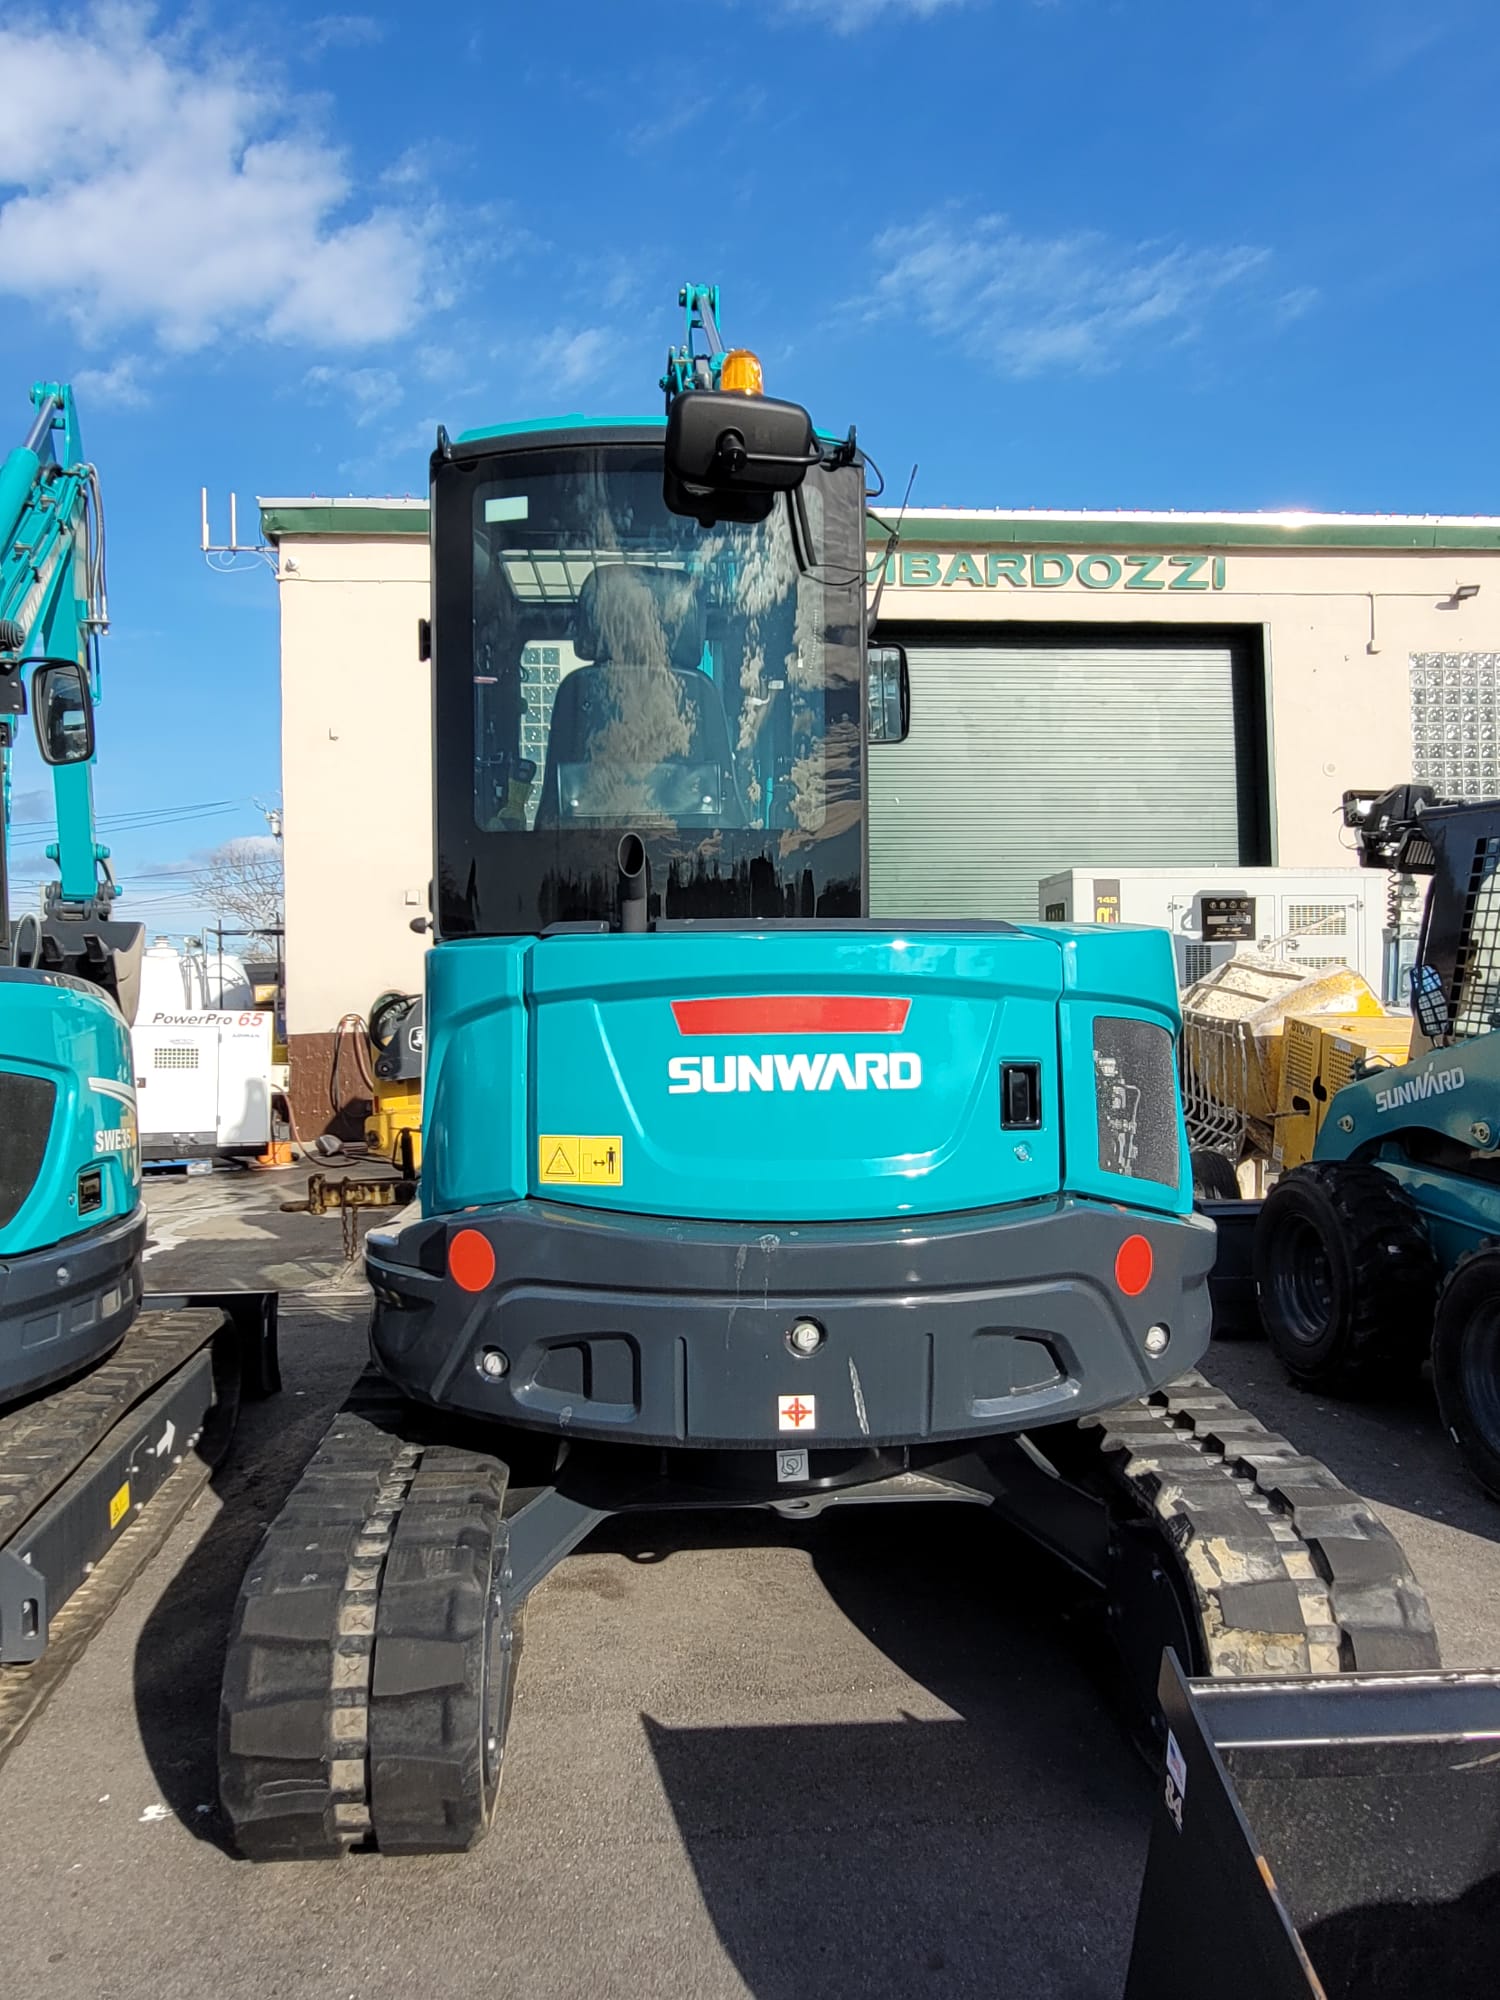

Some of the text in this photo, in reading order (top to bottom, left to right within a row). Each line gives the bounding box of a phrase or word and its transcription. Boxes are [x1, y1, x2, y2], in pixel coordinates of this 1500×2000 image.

[152, 1012, 265, 1027] PowerPro 65
[668, 1052, 922, 1094] SUNWARD
[1375, 1061, 1465, 1113] SUNWARD
